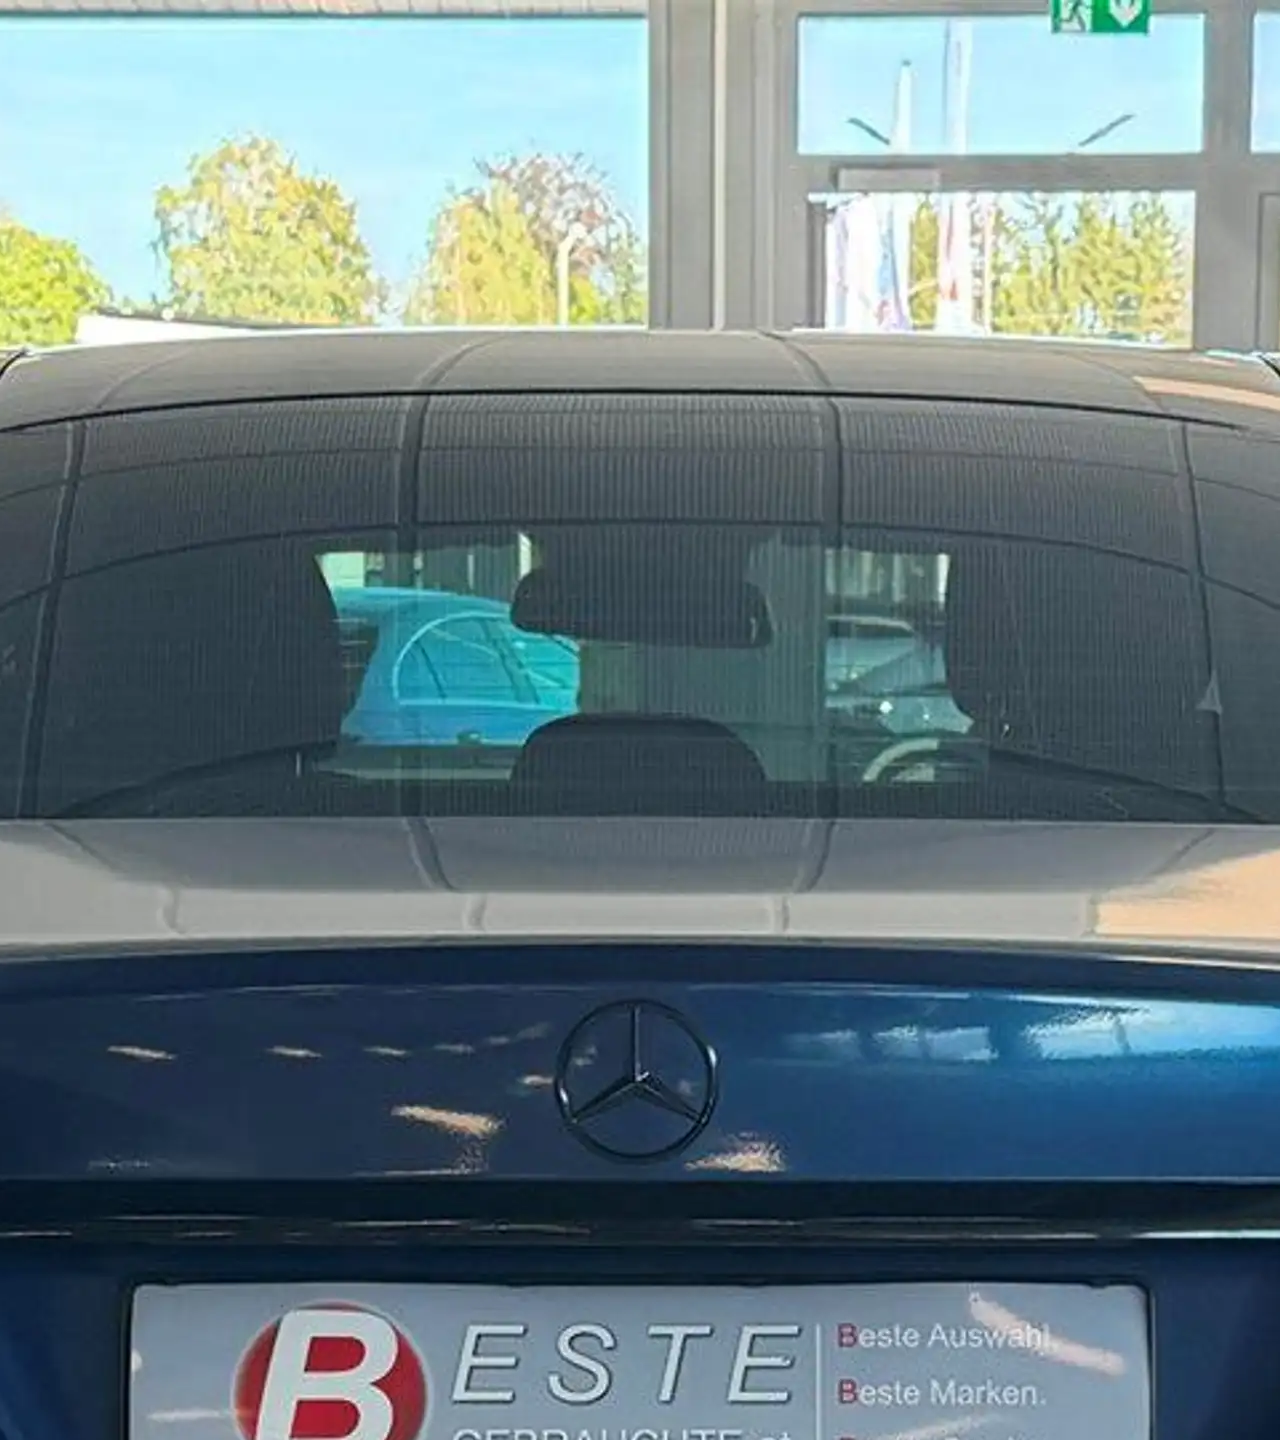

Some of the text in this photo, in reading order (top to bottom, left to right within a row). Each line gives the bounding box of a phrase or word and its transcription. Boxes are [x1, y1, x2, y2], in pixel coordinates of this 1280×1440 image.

[838, 1323, 920, 1349] Beste
[838, 1378, 1047, 1405] Beste Marken.
